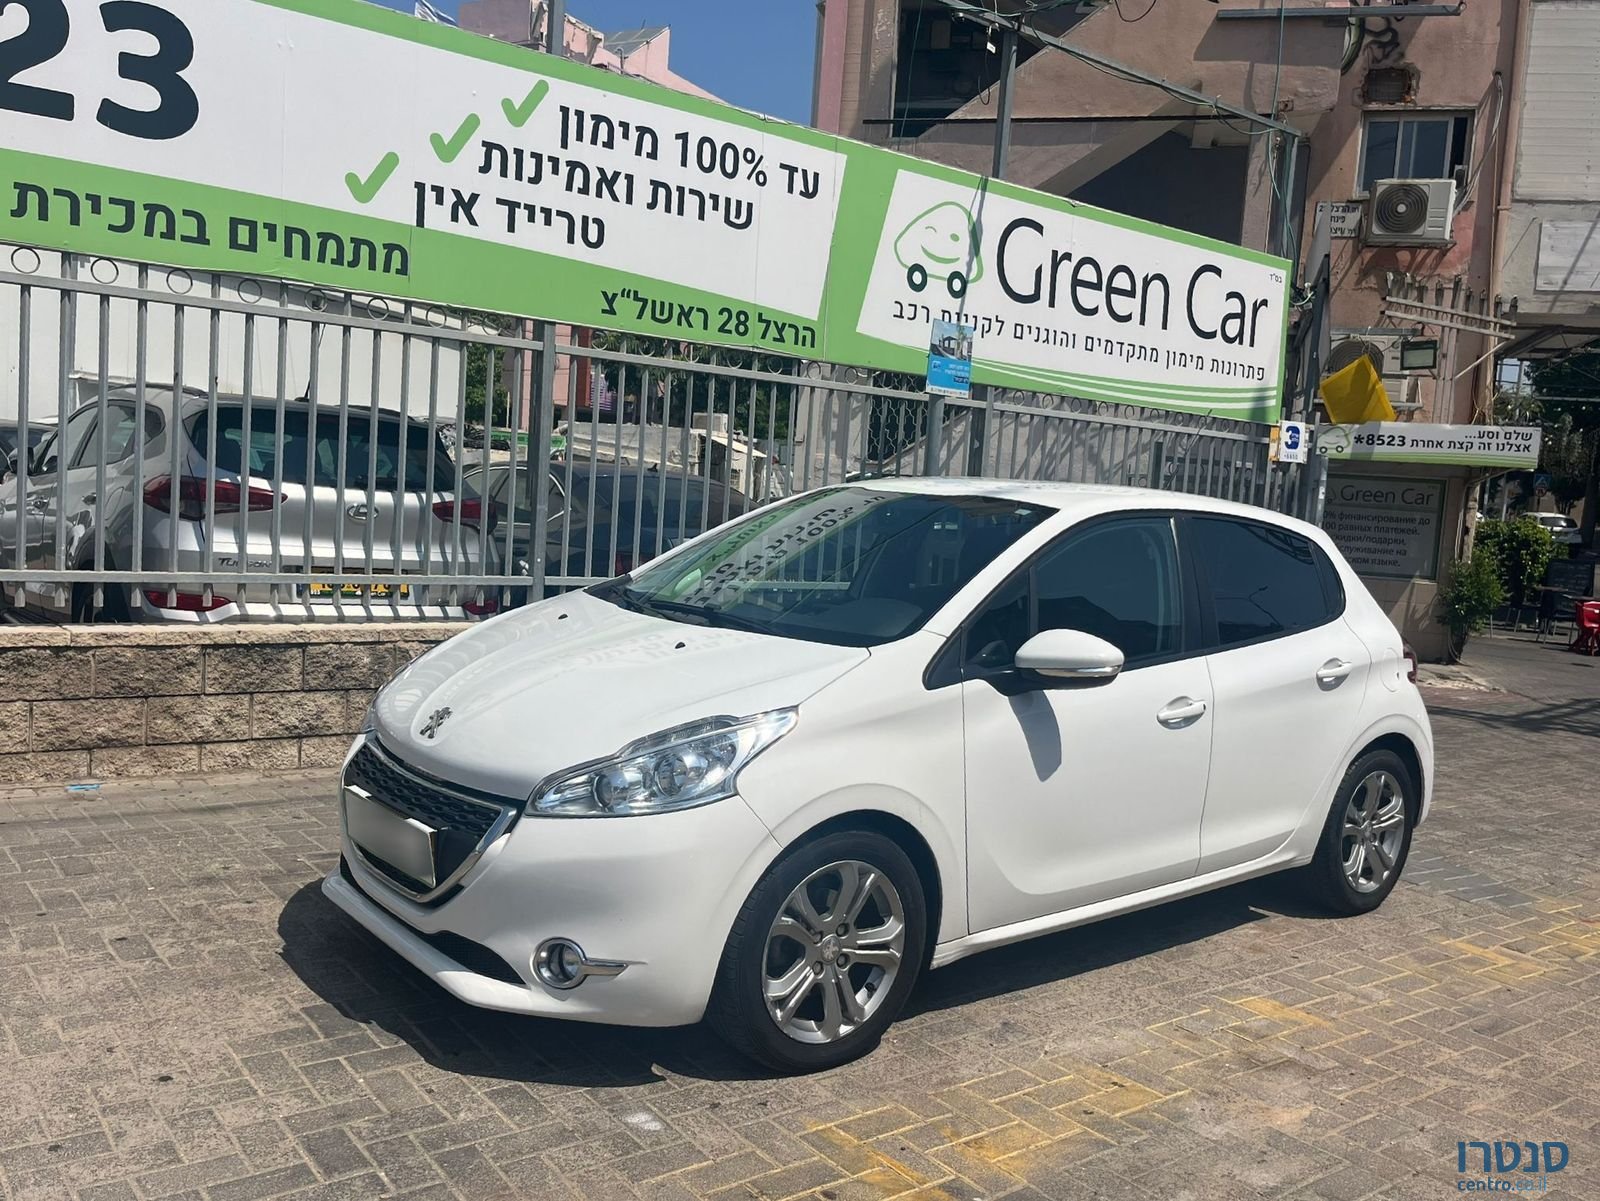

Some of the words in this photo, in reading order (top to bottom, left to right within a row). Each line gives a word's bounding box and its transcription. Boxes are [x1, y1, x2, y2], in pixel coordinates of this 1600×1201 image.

[559, 105, 658, 160] מימון
[478, 139, 633, 205] ואמינות
[674, 132, 767, 187] 100%
[779, 162, 820, 199] עד
[10, 181, 210, 247] במכירת
[414, 181, 480, 227] אין
[647, 178, 753, 229] שירות
[495, 198, 605, 249] טרייד
[229, 216, 409, 276] מתמחים
[996, 217, 1170, 331] Green
[1186, 264, 1268, 348] Car
[717, 307, 749, 336] 28
[893, 300, 930, 323] רכב
[757, 312, 816, 348] הרצל
[1013, 323, 1076, 349] והוגנים
[1085, 336, 1159, 363] מתקדמים
[1166, 350, 1204, 370] מימון
[1210, 358, 1265, 381] פתרונות
[1410, 439, 1443, 449] אחרת
[1448, 441, 1474, 453] קצת
[1478, 442, 1491, 451] זה
[1496, 441, 1532, 453] אצלנו
[1504, 430, 1533, 441] שלם
[1341, 485, 1396, 503] Green
[1401, 488, 1434, 506] Car
[1338, 511, 1416, 525] финансирование
[1418, 517, 1430, 526] до
[1338, 523, 1371, 532] равных
